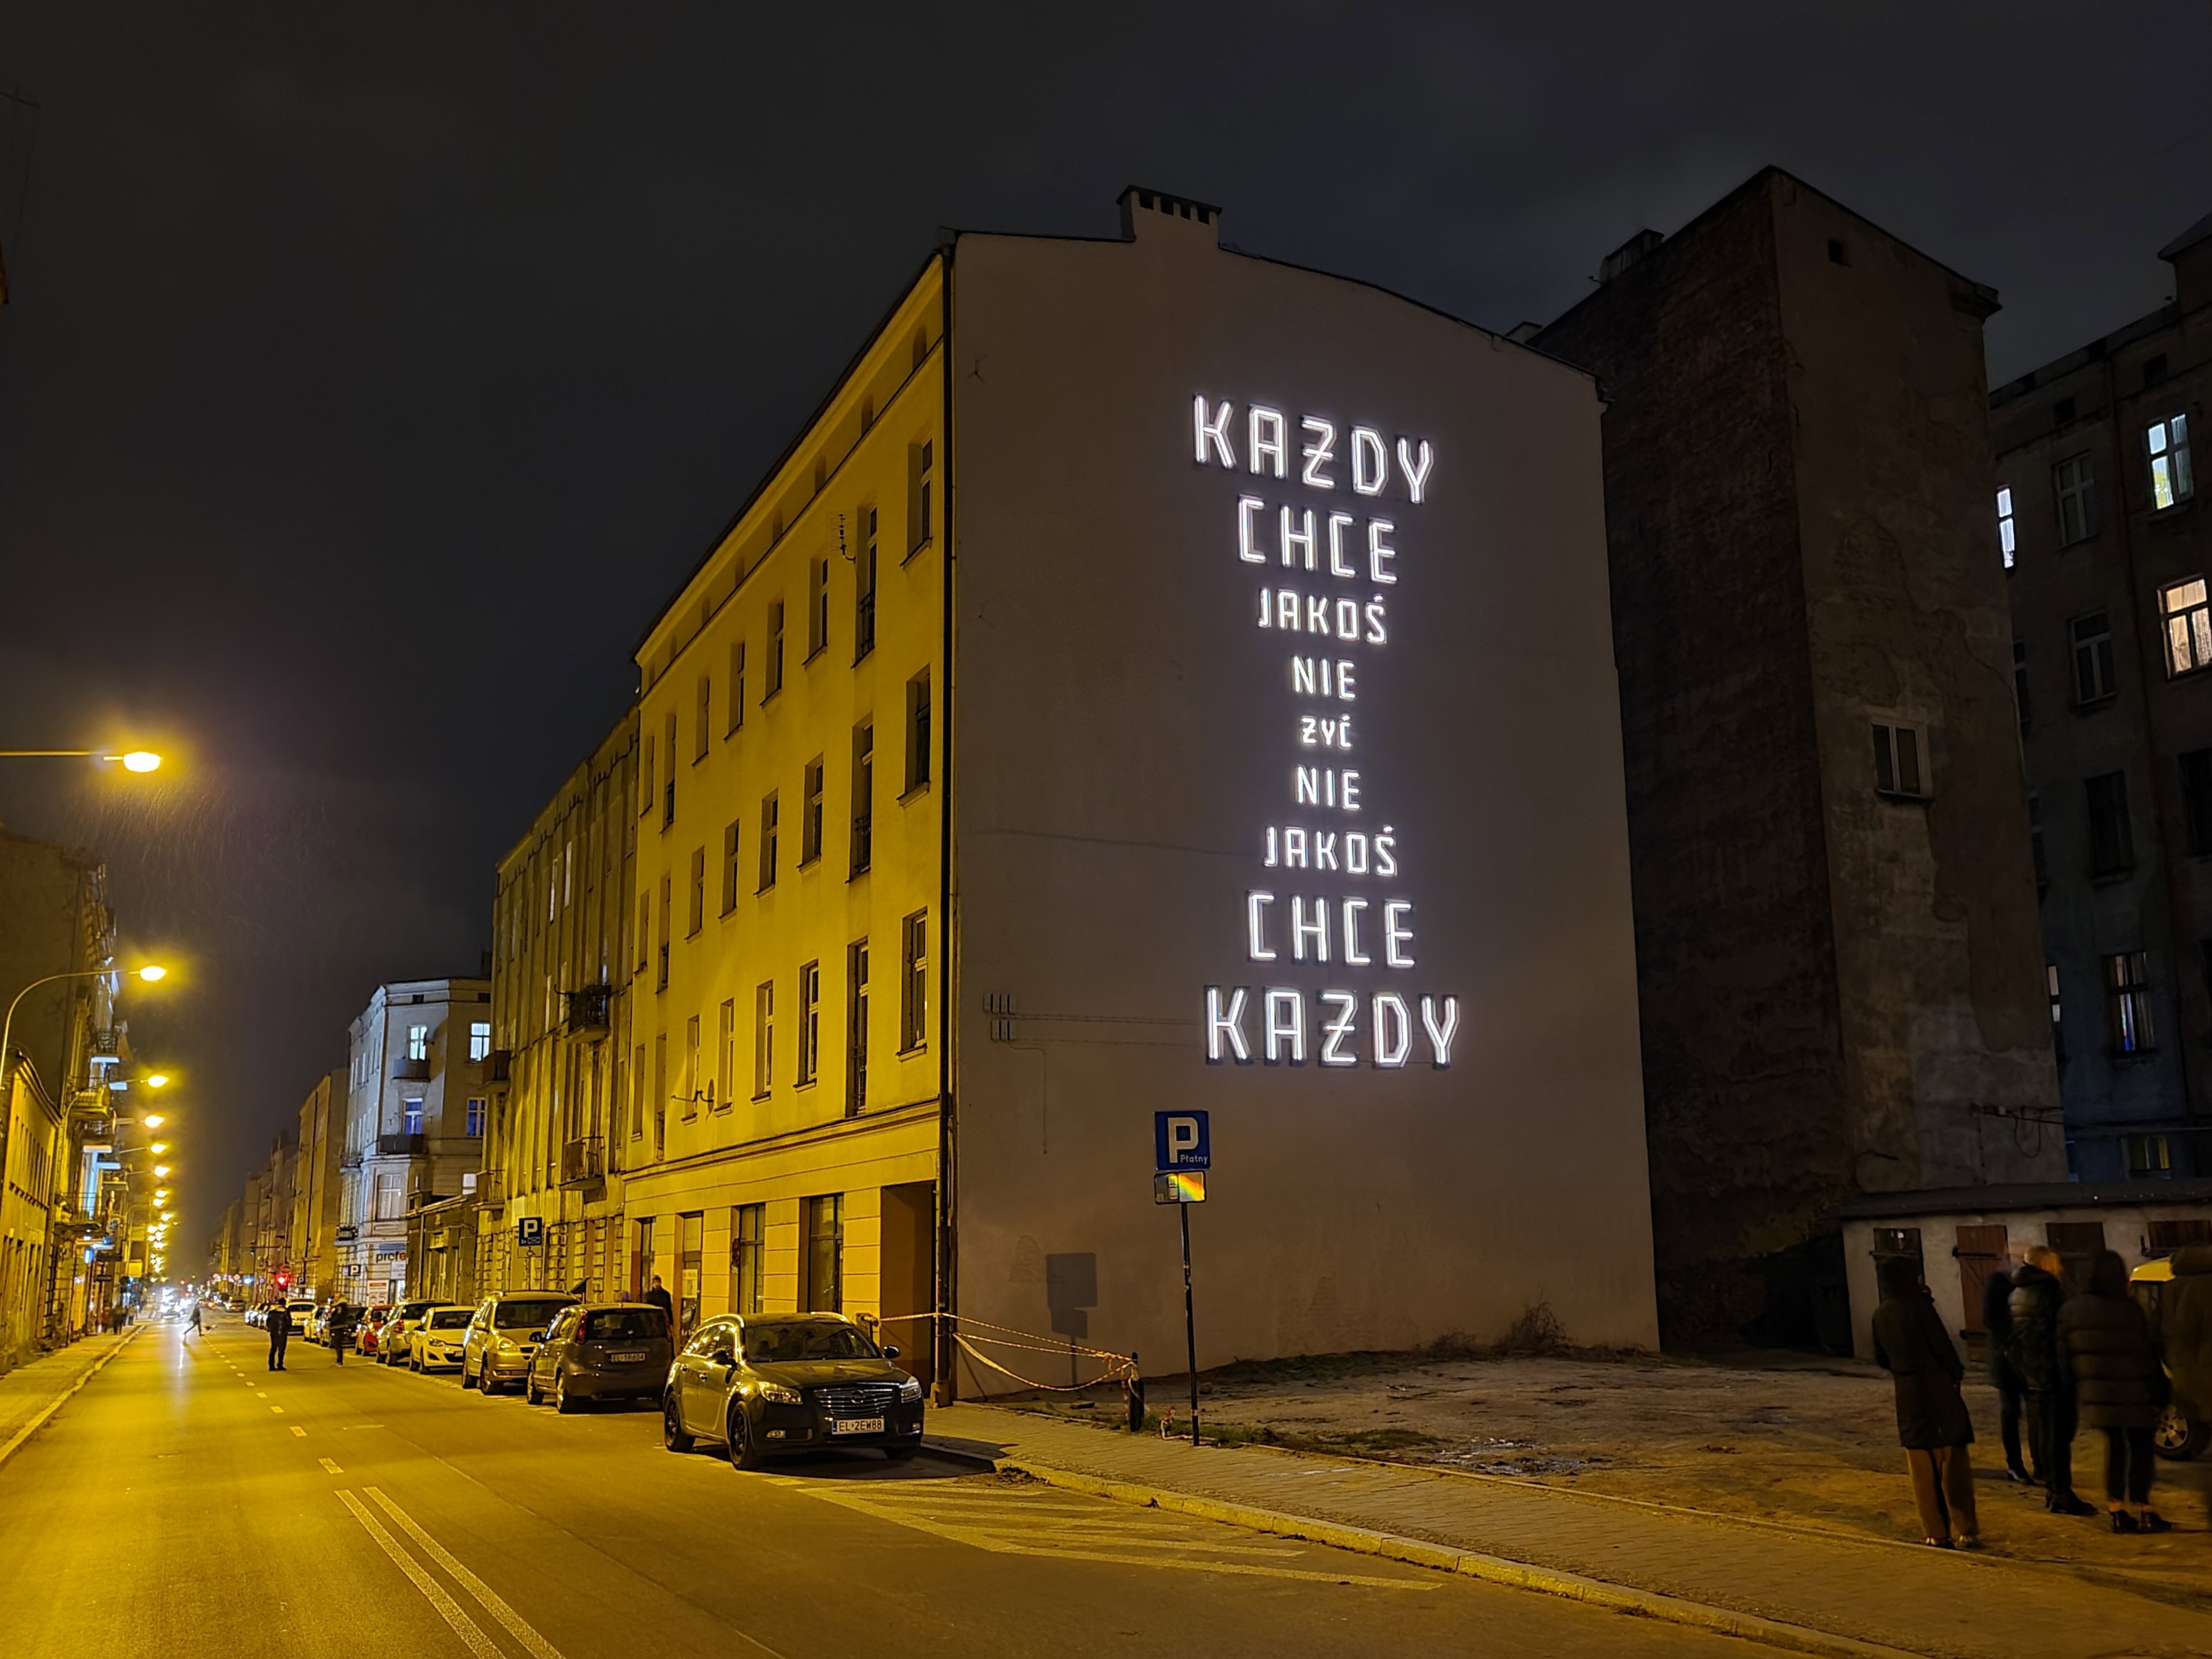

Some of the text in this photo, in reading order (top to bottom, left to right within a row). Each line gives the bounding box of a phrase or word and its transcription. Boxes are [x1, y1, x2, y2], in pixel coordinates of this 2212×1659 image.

[1238, 495, 1398, 584] CHCE
[1258, 587, 1387, 645] JAKOŚ
[1291, 655, 1357, 700] NIE
[1296, 765, 1361, 811] NIE
[1264, 825, 1397, 877] JAKOŚ
[1248, 891, 1416, 968] CHCE
[1167, 1117, 1199, 1164] P
[524, 1219, 538, 1238] P
